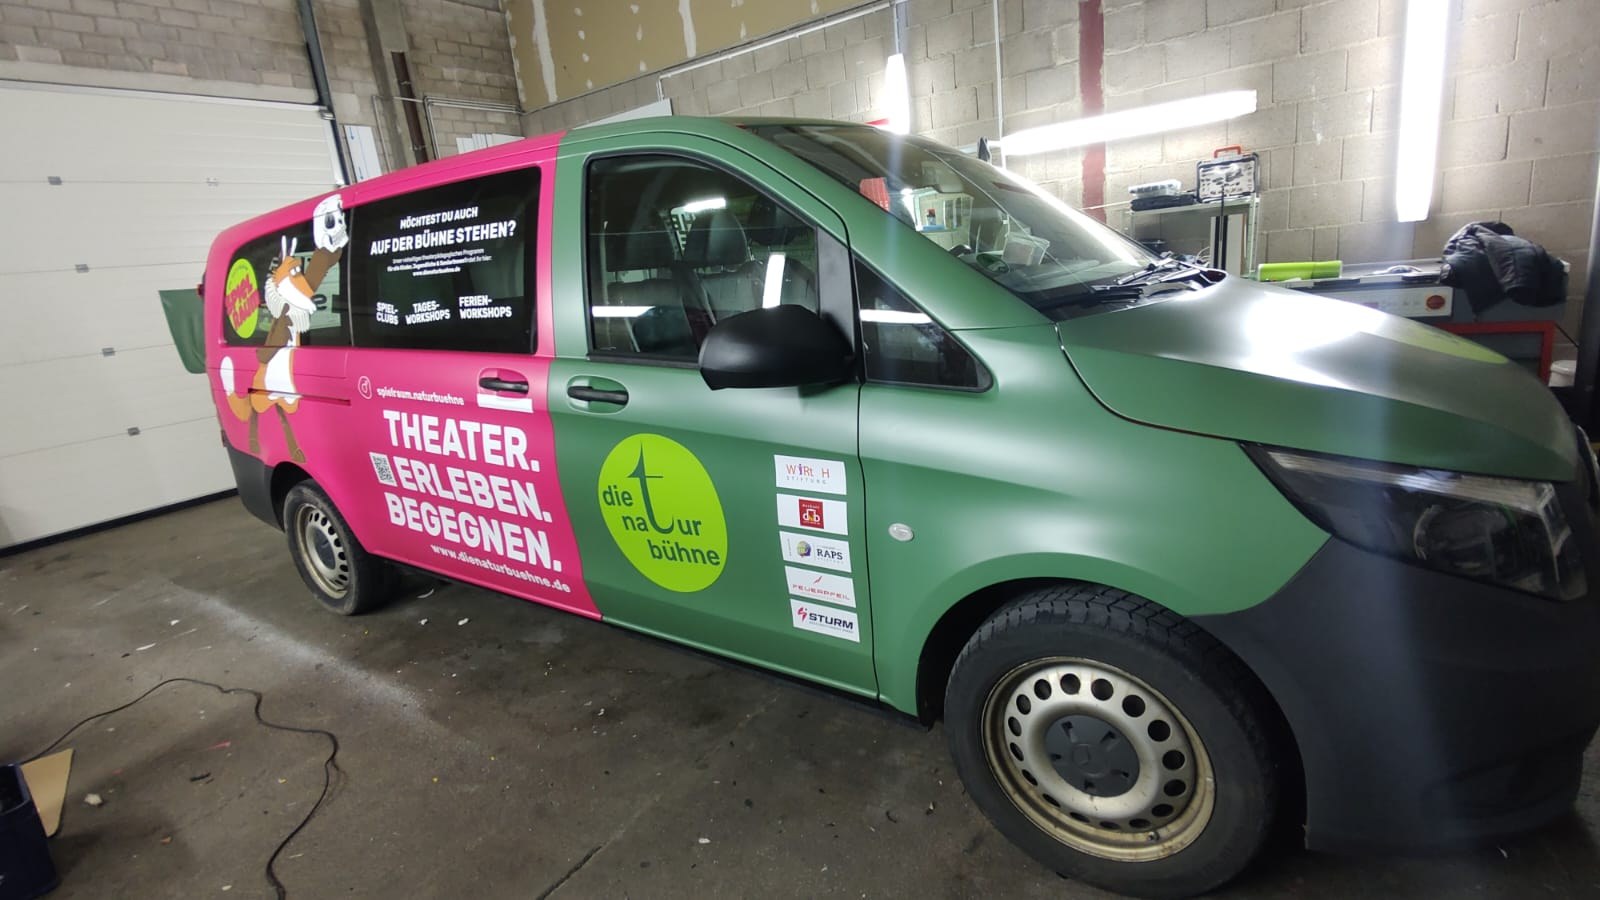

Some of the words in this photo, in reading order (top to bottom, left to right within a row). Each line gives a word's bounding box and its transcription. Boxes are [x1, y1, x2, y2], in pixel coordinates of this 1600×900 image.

[400, 213, 441, 230] MÖCHTEST
[441, 211, 453, 223] DU
[454, 206, 479, 219] AUCH
[370, 239, 391, 255] AUF
[392, 235, 413, 252] DER
[414, 230, 455, 249] BÜHNE
[456, 220, 516, 243] STEHEN?
[376, 302, 399, 315] SPIEL-
[412, 300, 440, 313] TAGES-
[459, 295, 493, 307] FERIEN-
[376, 313, 399, 325] CLUBS
[405, 309, 450, 325] WORKSHOPS
[459, 306, 512, 319] WORKSHOPS
[383, 409, 540, 473] THEATER.
[393, 455, 553, 523] ERLEBEN.
[602, 485, 634, 507] die
[384, 491, 562, 572] BEGEGNEN.
[647, 539, 721, 566] bühne
[816, 548, 843, 560] RAPS
[430, 544, 571, 593] www.dienaturbuehne.de
[809, 612, 854, 630] STURM
